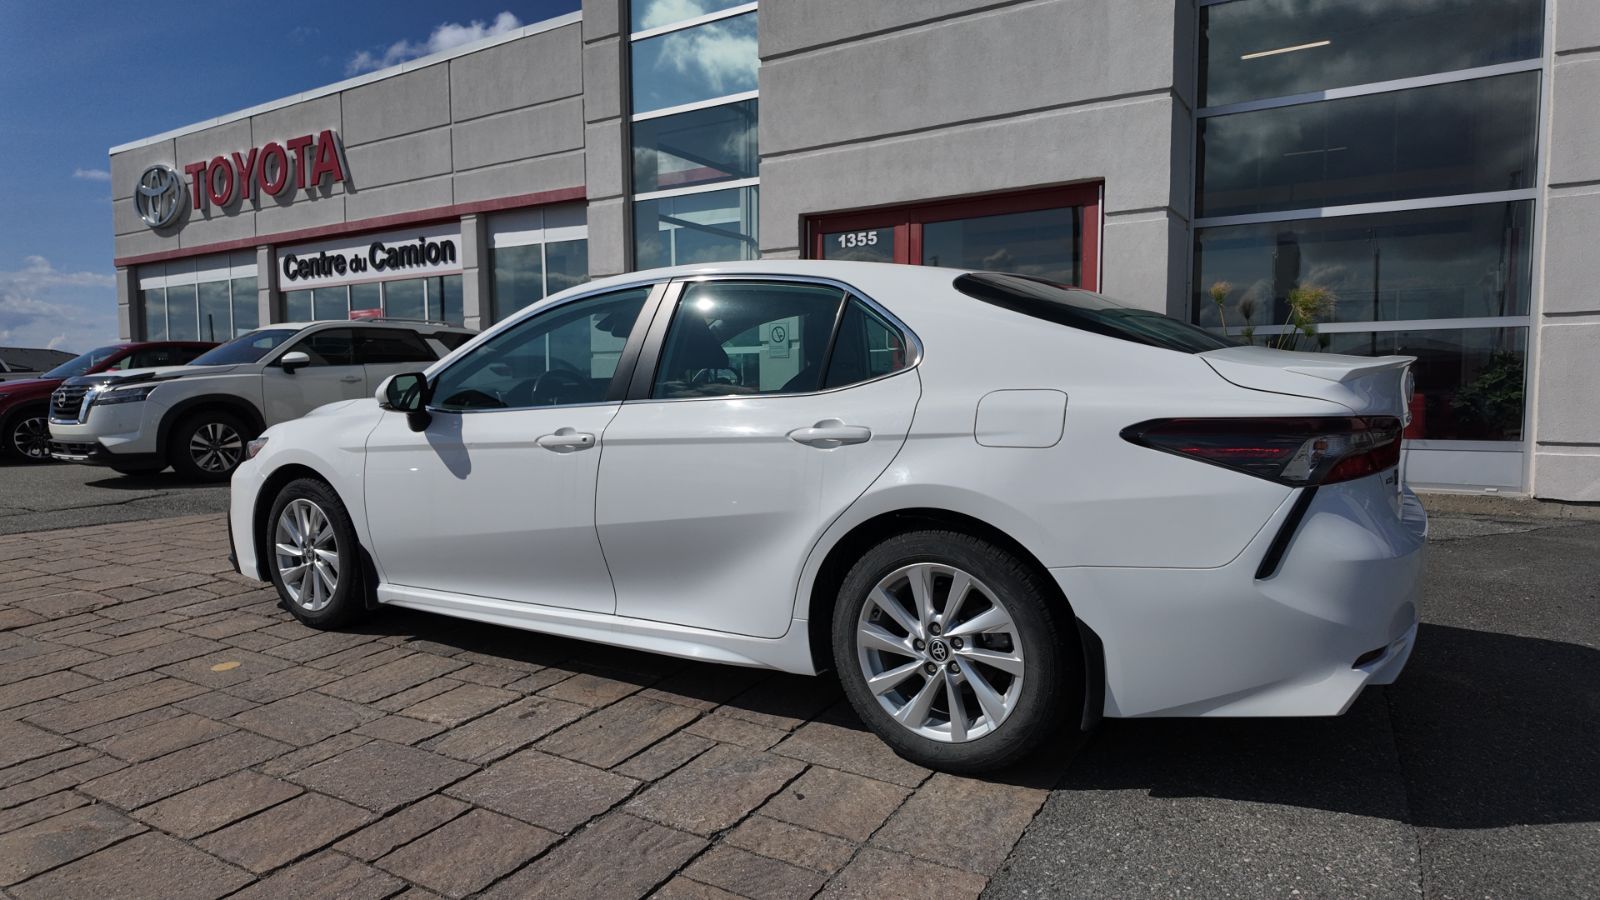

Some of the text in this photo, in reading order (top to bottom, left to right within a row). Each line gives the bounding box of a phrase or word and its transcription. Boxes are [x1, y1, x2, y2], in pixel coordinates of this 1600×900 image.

[185, 129, 344, 210] TOYOTA
[283, 236, 456, 280] Centre du Camion
[838, 231, 878, 248] 1355
